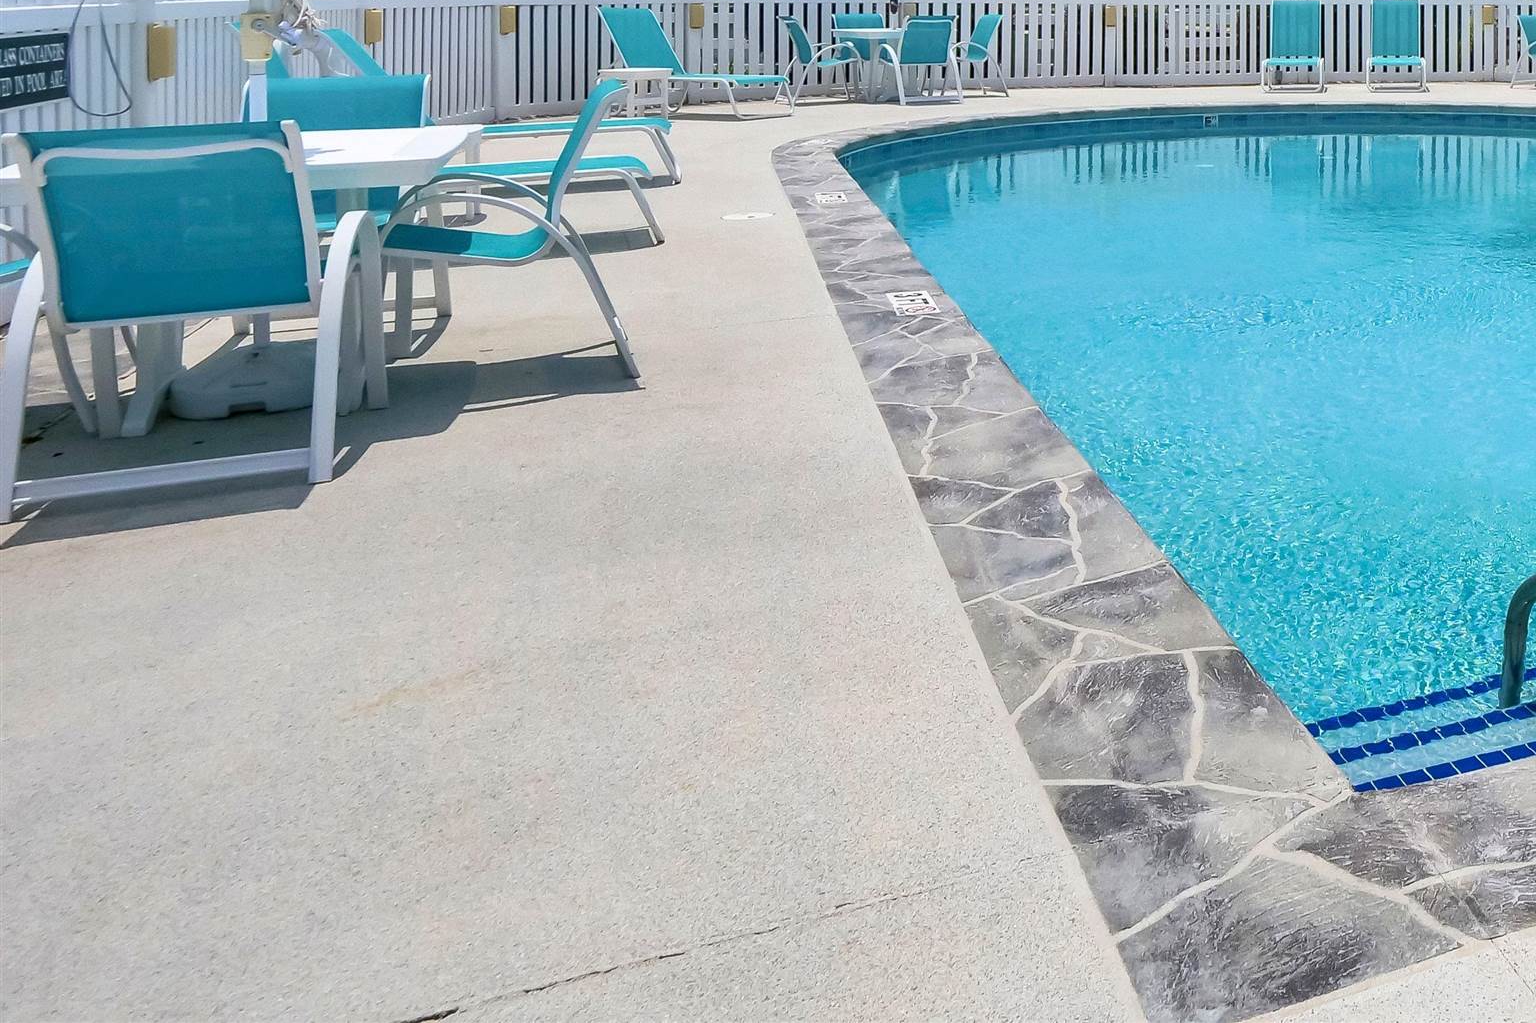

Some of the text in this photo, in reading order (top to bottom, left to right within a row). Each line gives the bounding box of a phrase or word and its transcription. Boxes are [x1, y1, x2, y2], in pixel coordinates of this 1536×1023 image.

[19, 43, 65, 66] CONTAINERS
[14, 75, 25, 95] IN
[27, 72, 47, 93] POOL
